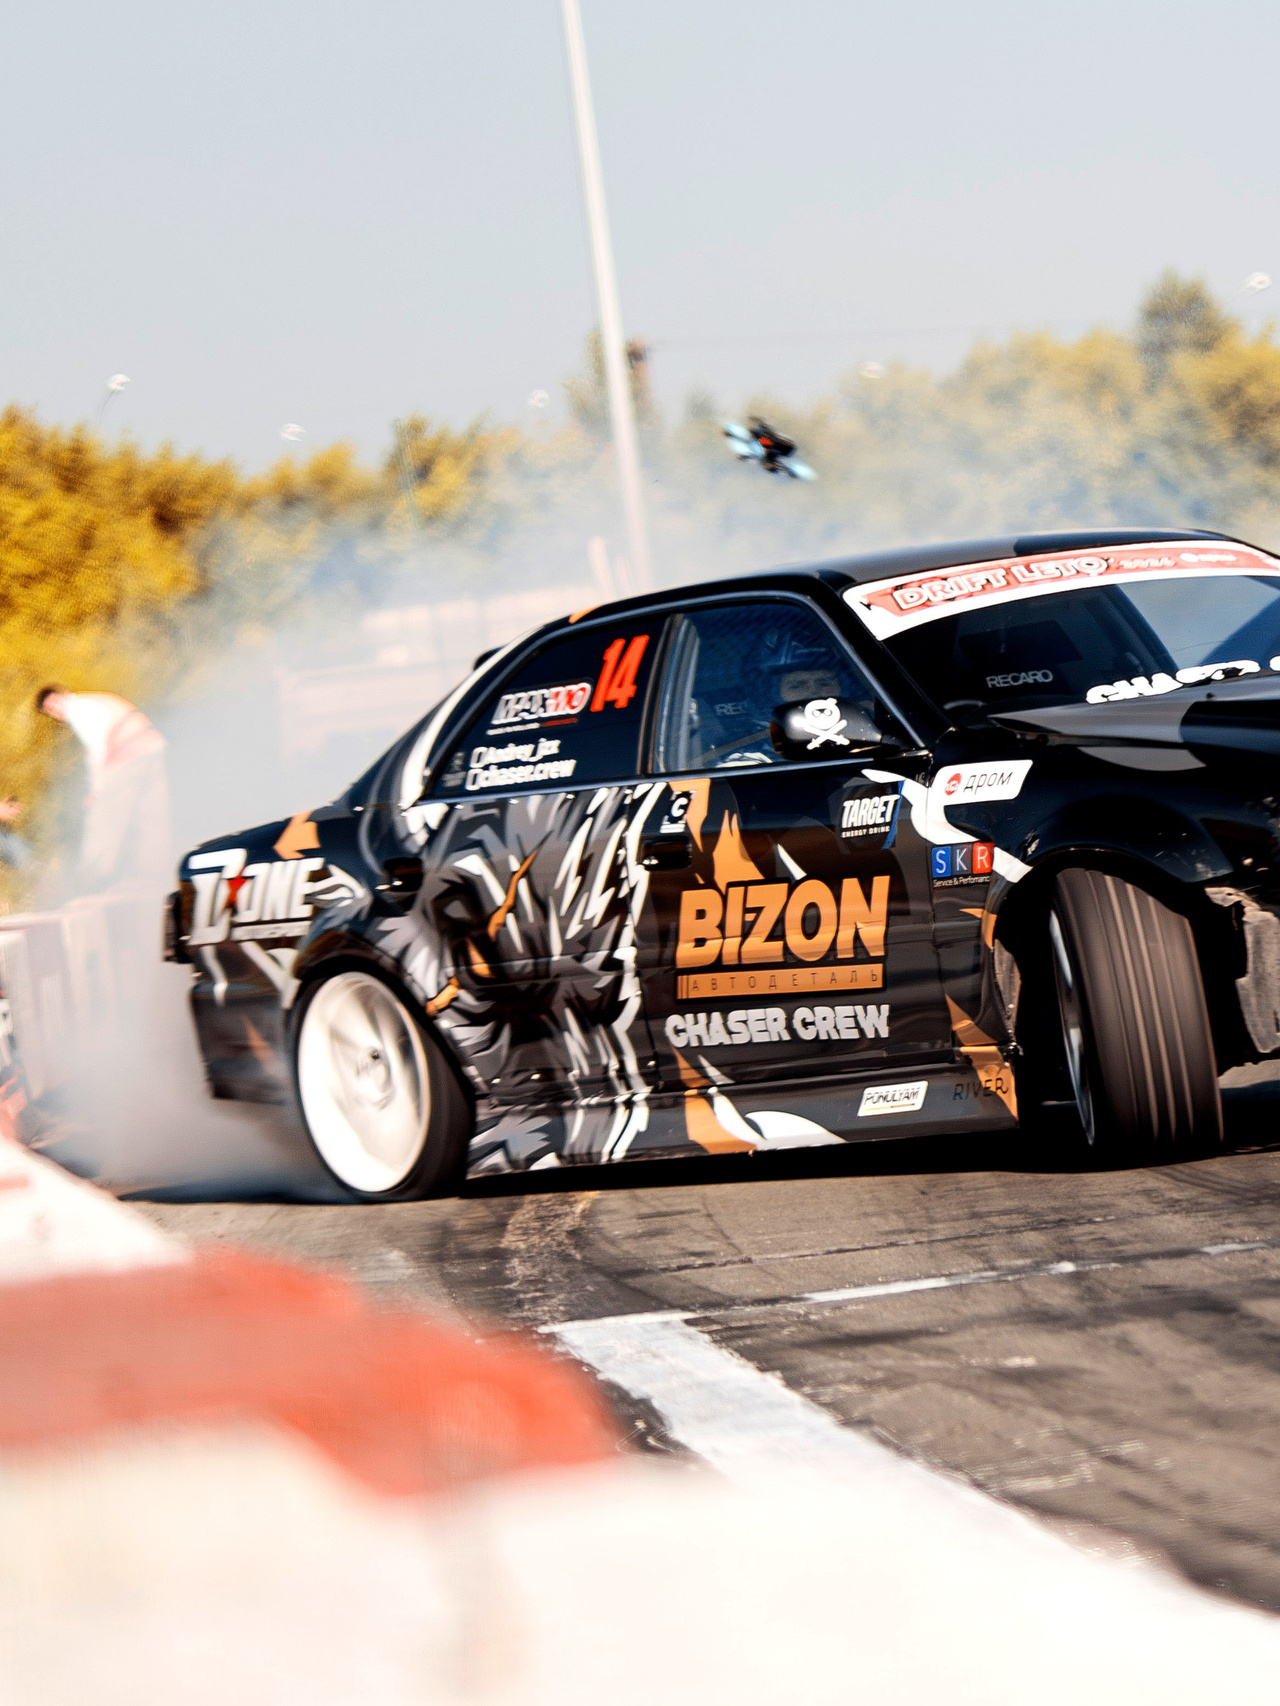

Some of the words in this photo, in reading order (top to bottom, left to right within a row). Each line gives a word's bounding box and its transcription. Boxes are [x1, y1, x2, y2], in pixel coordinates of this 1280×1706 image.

[892, 567, 1007, 609] DRIFT
[590, 634, 649, 712] 14
[985, 669, 1053, 689] RECARO
[841, 794, 901, 829] TARGET
[841, 829, 867, 839] ENERGY
[868, 825, 891, 835] DRINK
[935, 846, 989, 874] SKR
[676, 875, 890, 968] BIZON
[692, 969, 878, 991] АВТОДЕТАЛЬ
[664, 1011, 791, 1048] CHASER
[792, 1004, 890, 1041] CREW
[953, 1077, 1009, 1101] RIVER
